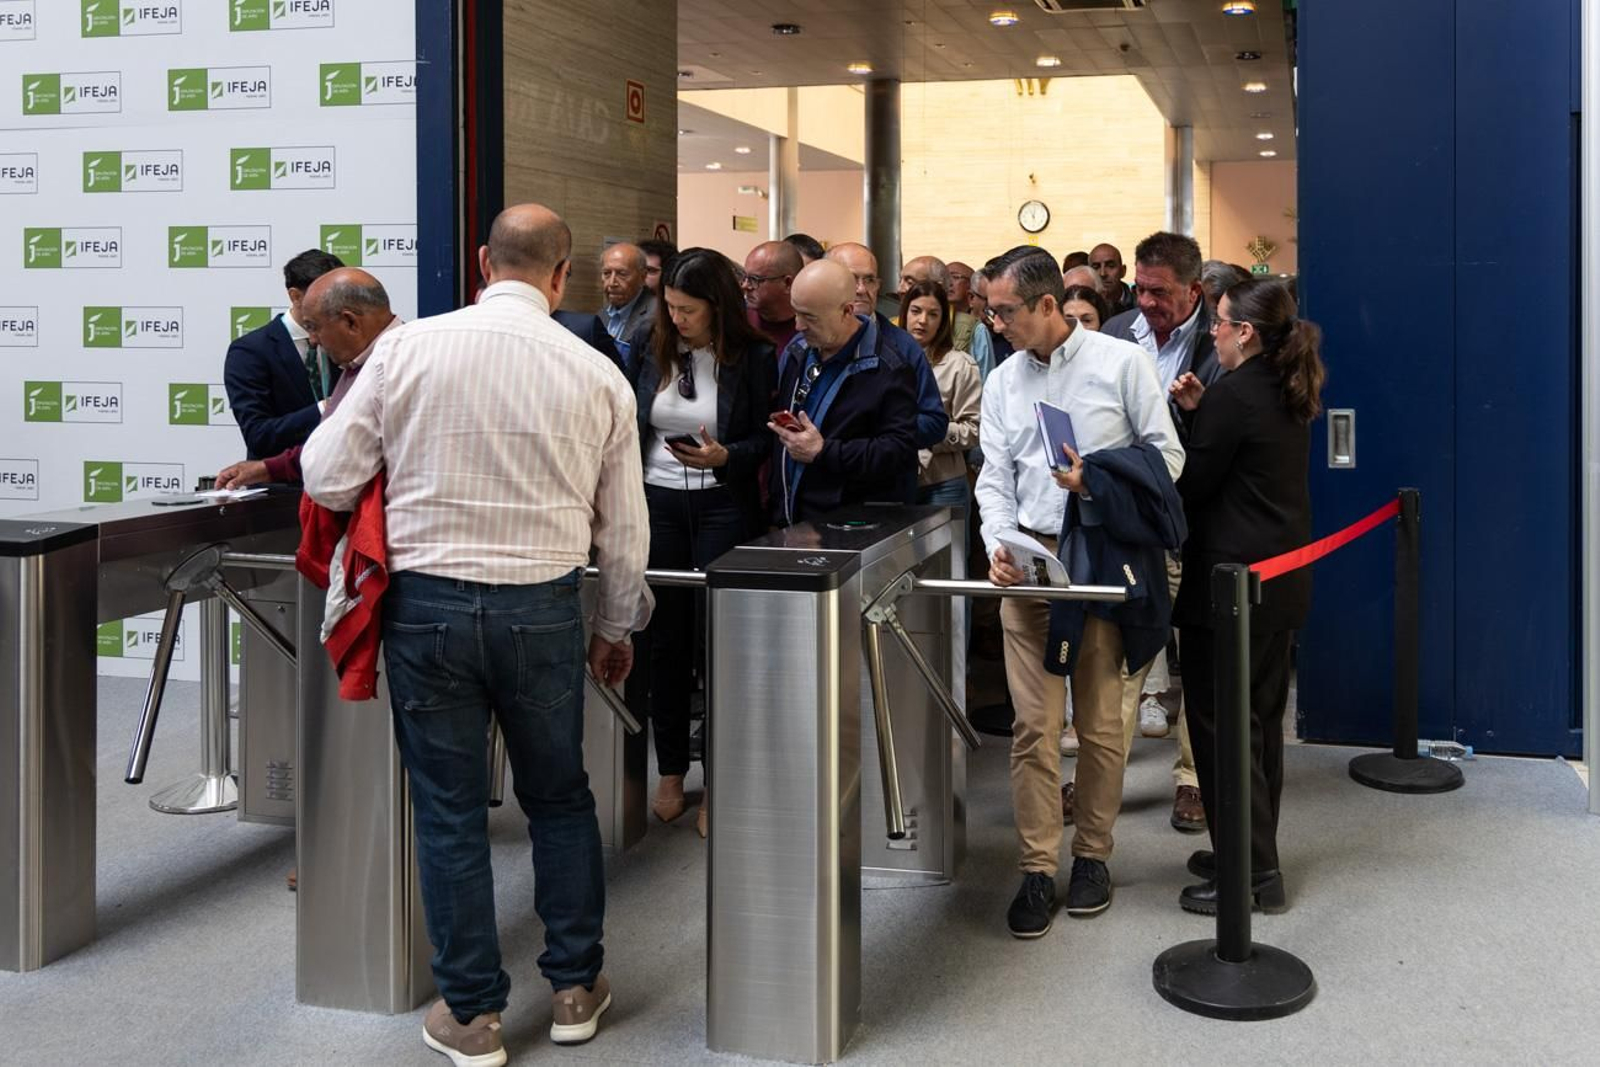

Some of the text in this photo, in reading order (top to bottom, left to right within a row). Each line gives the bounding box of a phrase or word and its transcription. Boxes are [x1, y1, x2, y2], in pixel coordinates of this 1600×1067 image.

[290, 0, 330, 12] IFEJA
[0, 13, 32, 25] FEJA
[140, 7, 178, 20] IFEJA
[80, 85, 117, 98] IFEJA
[228, 80, 266, 93] IFEJA
[2, 167, 33, 178] FEJA
[140, 163, 178, 176] IFEJA
[291, 160, 331, 173] IFEJA
[80, 240, 118, 253] IFEJA
[228, 239, 267, 252] IFEJA
[141, 320, 179, 333] IFEJA
[80, 395, 118, 408] IFEJA
[142, 477, 180, 490] IFEJA
[143, 631, 181, 645] IFEA
